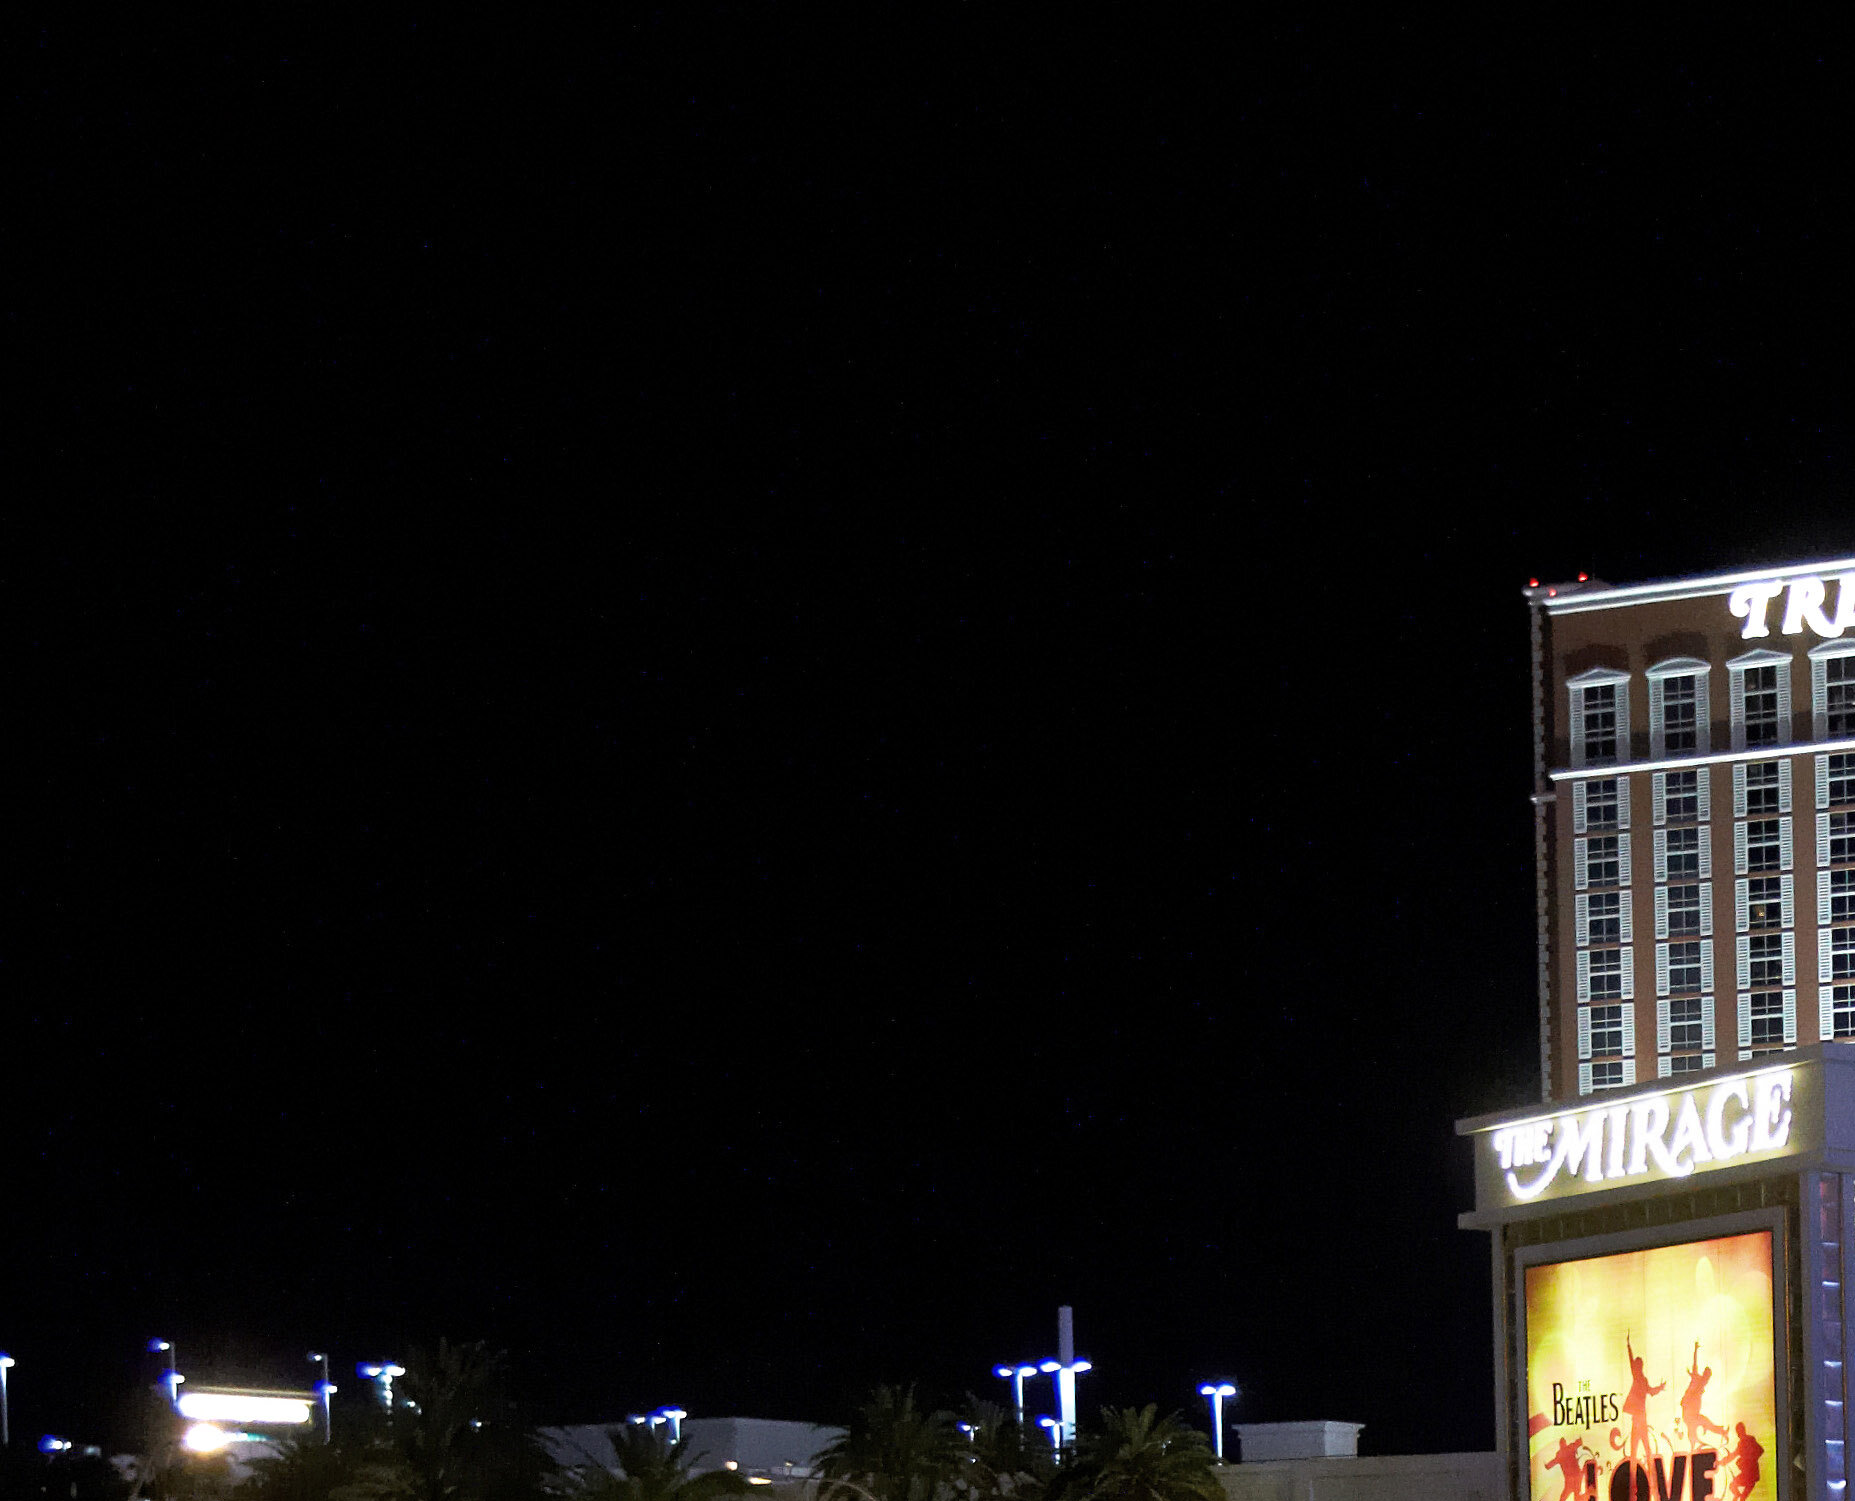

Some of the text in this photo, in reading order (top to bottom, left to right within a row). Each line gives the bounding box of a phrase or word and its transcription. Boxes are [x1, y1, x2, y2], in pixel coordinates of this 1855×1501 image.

[1492, 1069, 1794, 1200] THE MIRAGE
[1578, 1379, 1591, 1393] THE
